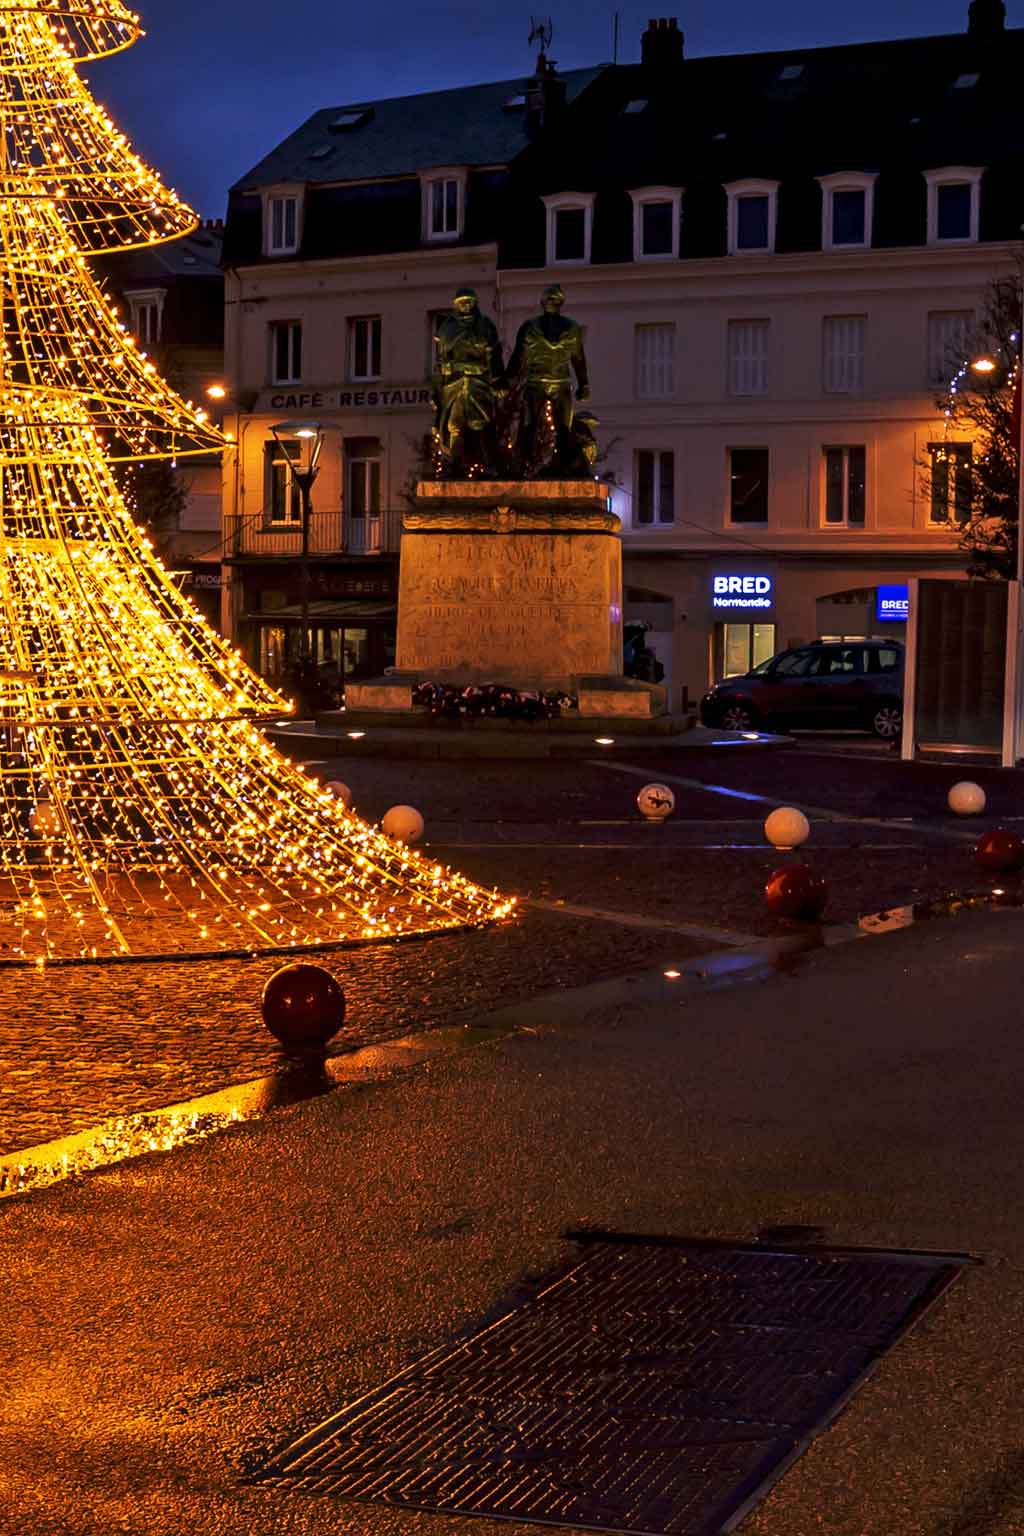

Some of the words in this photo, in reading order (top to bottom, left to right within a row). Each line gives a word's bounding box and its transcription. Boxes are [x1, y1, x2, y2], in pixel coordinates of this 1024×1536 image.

[271, 392, 323, 409] CAFÉ
[340, 389, 431, 406] RESTAUR
[713, 576, 771, 593] BRED
[713, 597, 772, 607] Normandie
